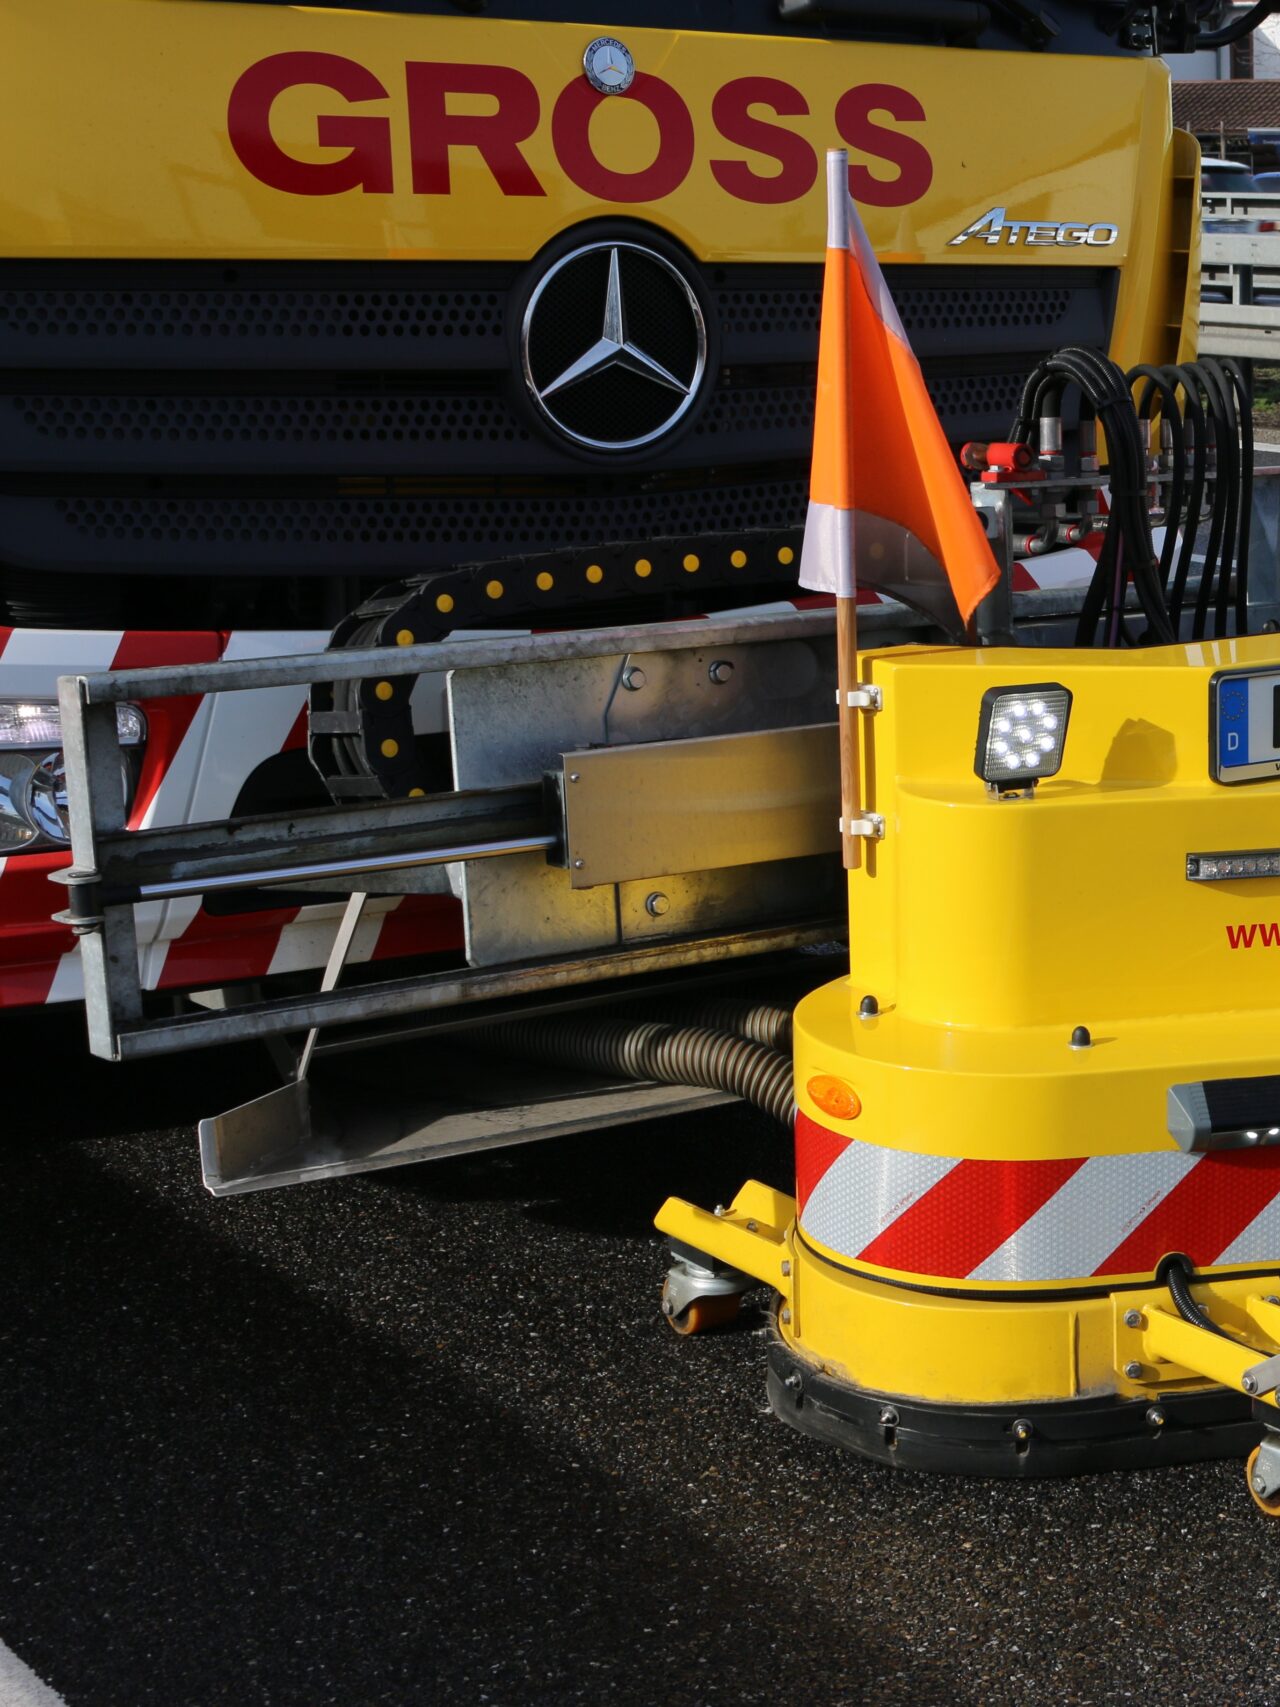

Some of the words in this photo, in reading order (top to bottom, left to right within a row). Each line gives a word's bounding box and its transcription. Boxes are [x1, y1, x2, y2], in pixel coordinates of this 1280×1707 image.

[227, 51, 934, 207] GROSS
[947, 207, 1119, 246] ATEGO
[1227, 732, 1239, 751] D
